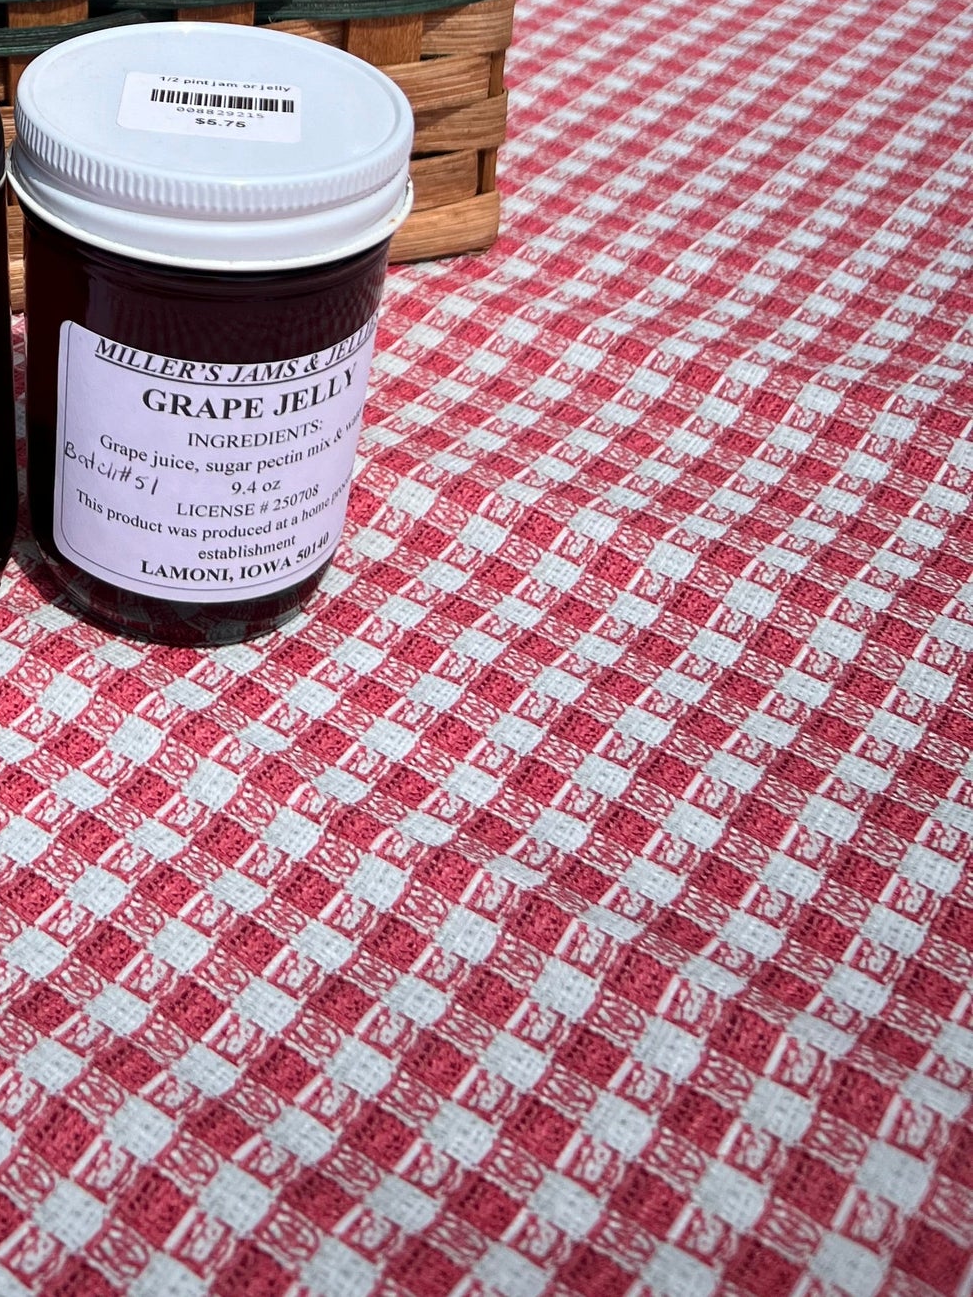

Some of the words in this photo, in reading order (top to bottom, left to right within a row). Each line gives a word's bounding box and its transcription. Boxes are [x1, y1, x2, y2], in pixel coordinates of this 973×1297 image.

[183, 78, 209, 86] pint
[211, 79, 239, 88] jam
[242, 82, 257, 90] or
[258, 83, 291, 93] jelly
[176, 106, 266, 119] 008829215
[95, 337, 223, 382] MILLER'S
[227, 360, 300, 383] JAMS
[303, 353, 320, 373] &
[142, 388, 263, 420] GRAPE
[273, 361, 357, 416] JELLY
[188, 418, 324, 449] INGREDIENTS:
[100, 434, 148, 462] Grape
[150, 451, 199, 473] juice,
[205, 460, 253, 476] sugar
[257, 449, 303, 474] pectin
[307, 438, 331, 458] mix
[333, 427, 343, 443] &
[177, 503, 256, 518] LICENSE
[260, 500, 269, 514] #
[272, 483, 320, 512] 250708
[231, 480, 257, 495] 9.4
[262, 479, 282, 493] oz
[76, 488, 103, 514] This
[107, 508, 163, 534] product
[168, 525, 197, 538] was
[202, 521, 272, 541] produced
[275, 518, 287, 531] at
[290, 516, 298, 526] a
[302, 499, 330, 522] home
[140, 560, 234, 583] LAMONI,
[240, 557, 292, 579] IOWA
[295, 531, 330, 563] 50140
[198, 535, 296, 561] establishment
